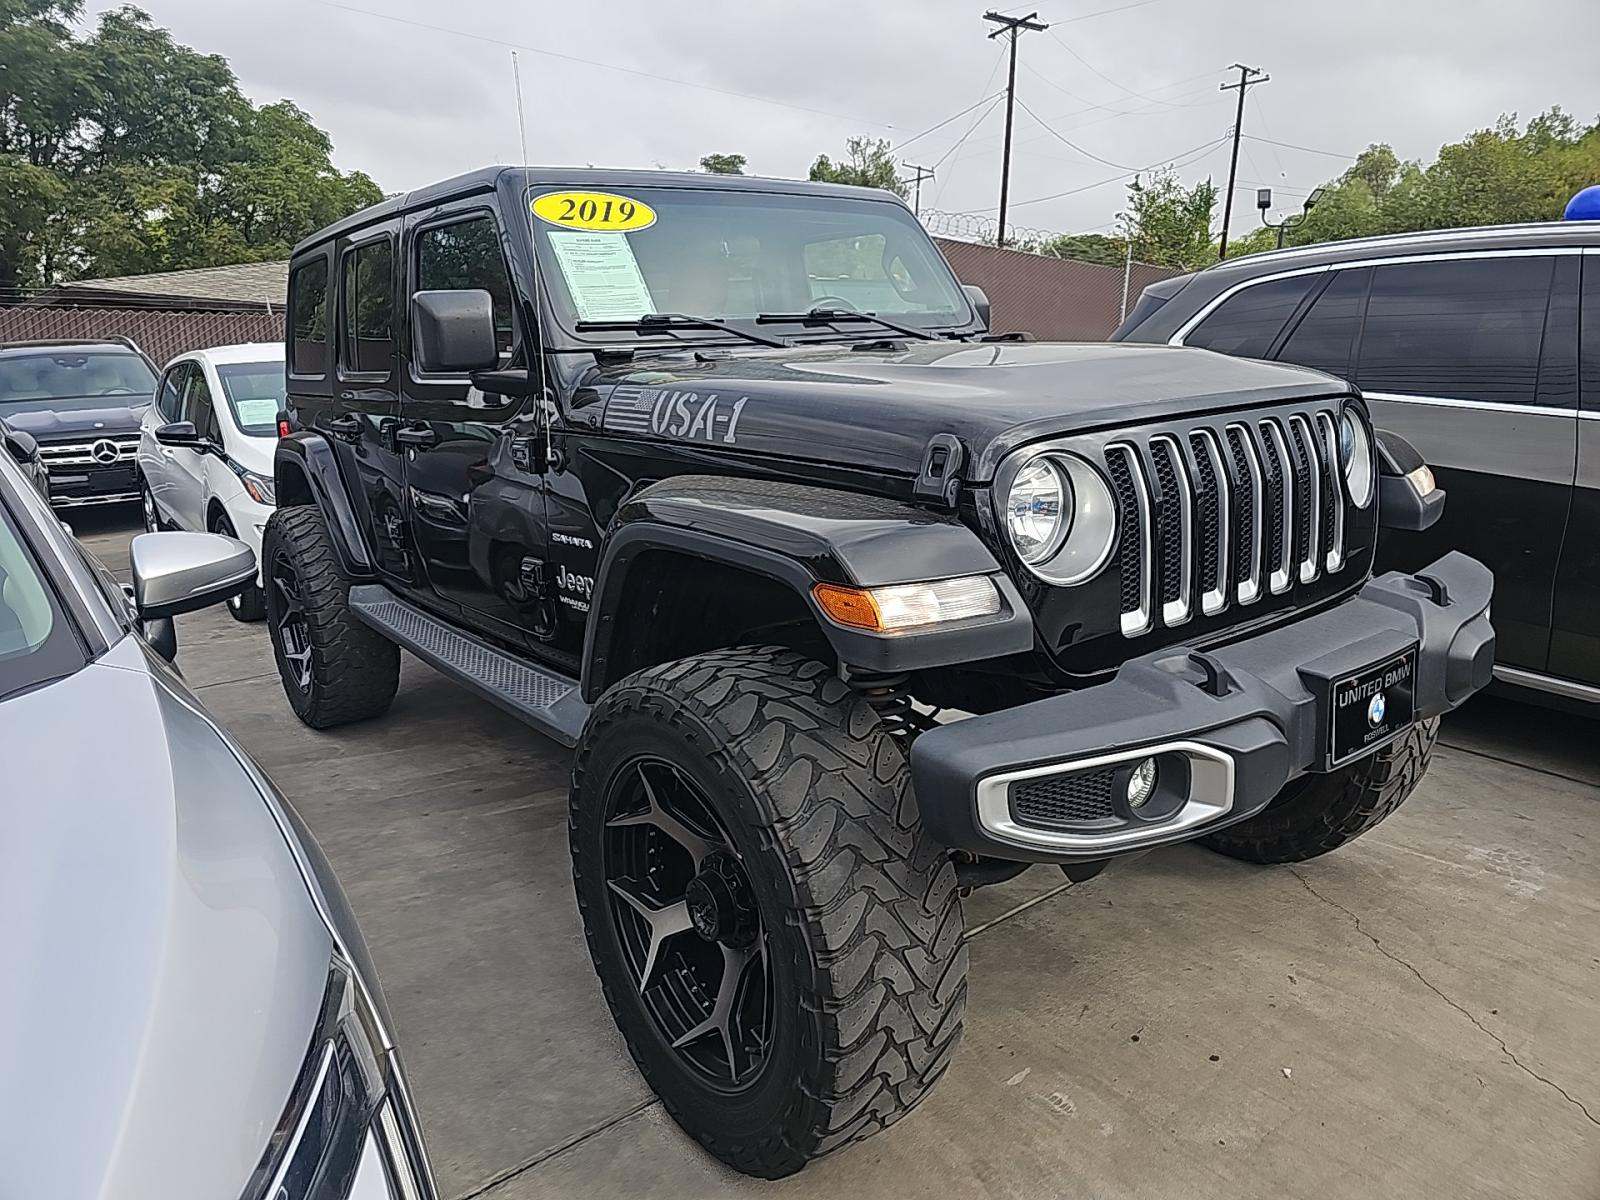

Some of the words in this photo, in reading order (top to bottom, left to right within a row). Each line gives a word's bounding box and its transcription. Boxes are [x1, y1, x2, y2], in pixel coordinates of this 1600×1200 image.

[558, 198, 635, 223] 2019
[652, 390, 750, 443] USA-1
[556, 564, 594, 600] Jeep
[1339, 677, 1383, 707] UNITED
[1384, 662, 1412, 688] BMW
[1363, 723, 1390, 744] ROSWELL
